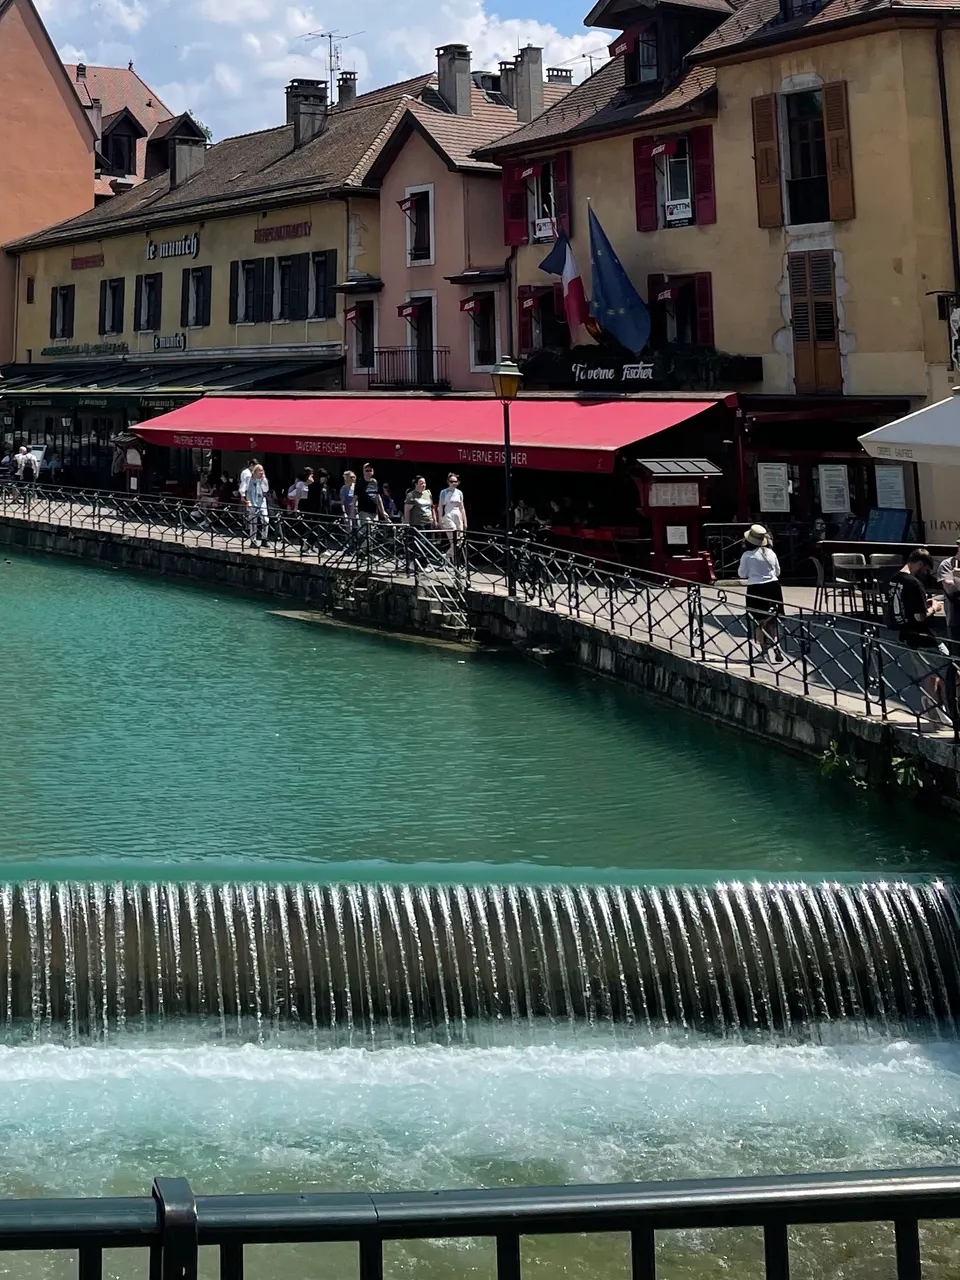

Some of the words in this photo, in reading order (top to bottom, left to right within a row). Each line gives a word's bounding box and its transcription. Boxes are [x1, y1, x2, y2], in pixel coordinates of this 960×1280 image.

[146, 240, 156, 260] le
[159, 232, 199, 259] munich
[571, 363, 615, 382] Taverne
[621, 361, 655, 381] Fischer
[173, 435, 194, 446] TAVERNE
[194, 436, 214, 447] FISCHER
[295, 440, 321, 453] TAVERNE
[322, 442, 347, 454] FISCHER
[457, 449, 493, 463] TAVERNE
[494, 451, 528, 465] FISHER
